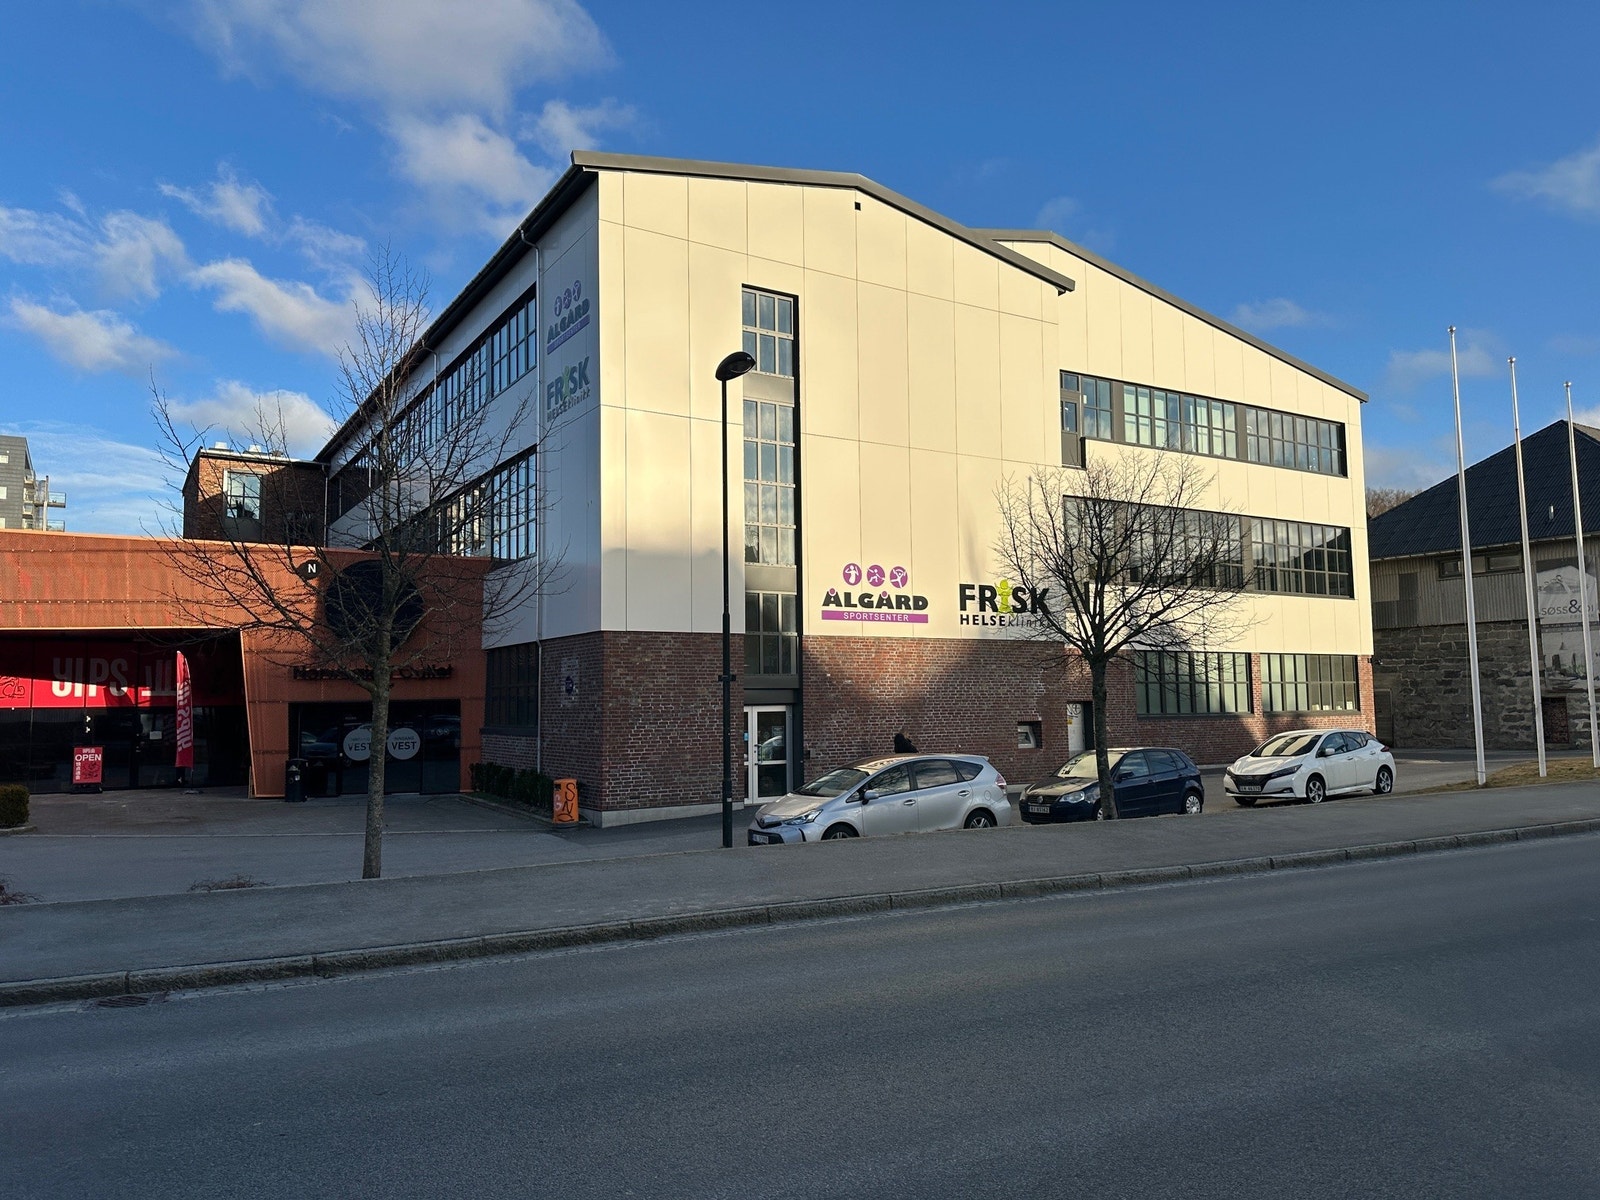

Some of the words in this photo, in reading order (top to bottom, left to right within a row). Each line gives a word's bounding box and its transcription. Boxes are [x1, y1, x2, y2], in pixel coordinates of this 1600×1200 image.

[547, 356, 590, 410] FRISK
[307, 564, 317, 573] N
[959, 582, 1050, 614] FRISK
[843, 612, 909, 622] SPORTSENTER
[51, 657, 128, 697] YIPS
[391, 741, 417, 750] VEST
[74, 753, 102, 762] OPEN
